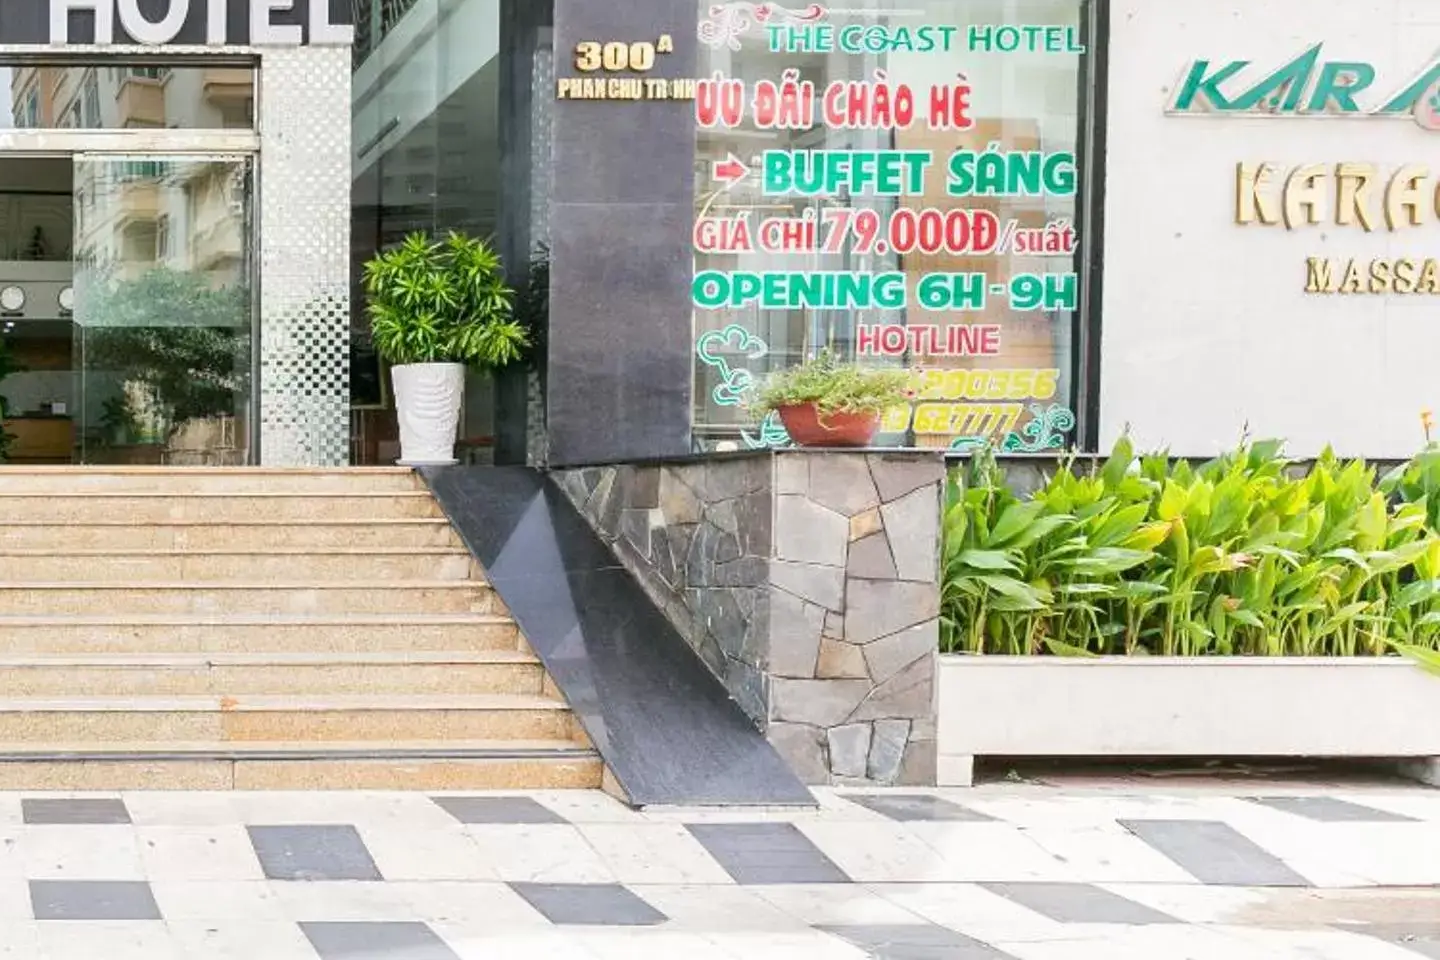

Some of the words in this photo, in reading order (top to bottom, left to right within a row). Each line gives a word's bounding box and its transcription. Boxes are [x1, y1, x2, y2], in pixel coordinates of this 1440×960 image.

[765, 23, 834, 52] THE
[839, 24, 958, 54] COAST
[967, 23, 1086, 54] HOTEL
[558, 79, 605, 100] PHAN
[608, 79, 642, 100] CHU
[751, 68, 815, 129] ĐÃI
[823, 68, 914, 130] CHÀO
[928, 72, 976, 130] HÈ
[762, 149, 933, 196] BUFFET
[946, 141, 1077, 196] SÁNG
[1234, 162, 1440, 232] KARA
[693, 211, 756, 254] GIÁ
[692, 270, 906, 309] OPENING
[856, 323, 1001, 356] HOTLINE
